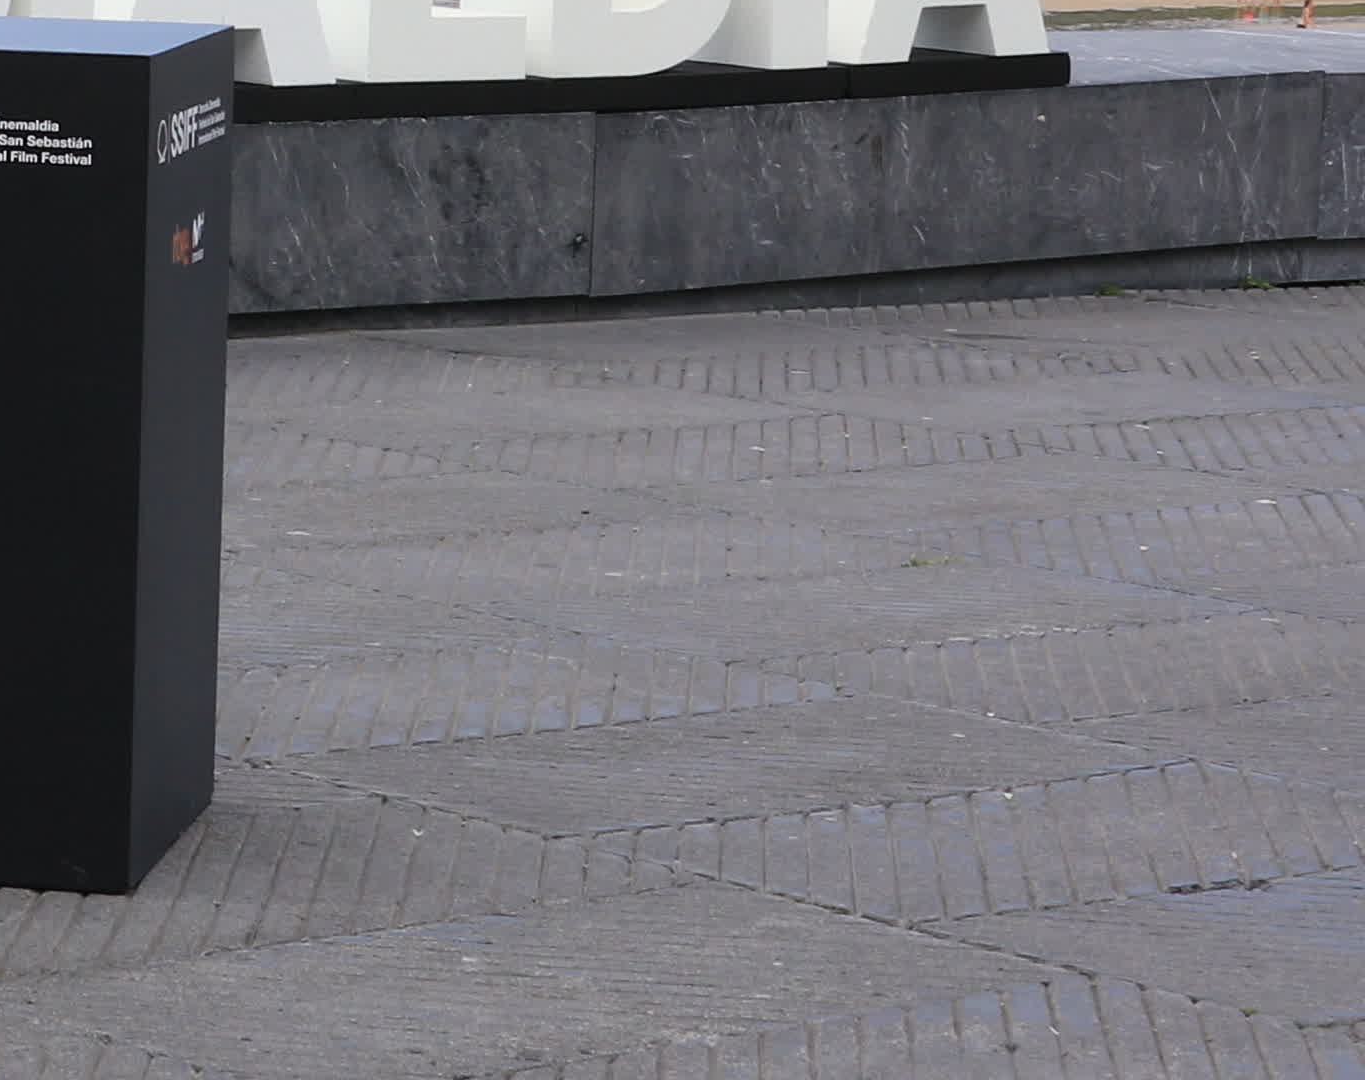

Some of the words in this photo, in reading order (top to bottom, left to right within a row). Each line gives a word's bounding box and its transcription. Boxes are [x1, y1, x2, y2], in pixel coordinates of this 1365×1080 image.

[171, 105, 198, 158] SSIFF
[27, 135, 93, 149] Sebastián
[10, 151, 38, 163] Film
[41, 152, 92, 166] Festival
